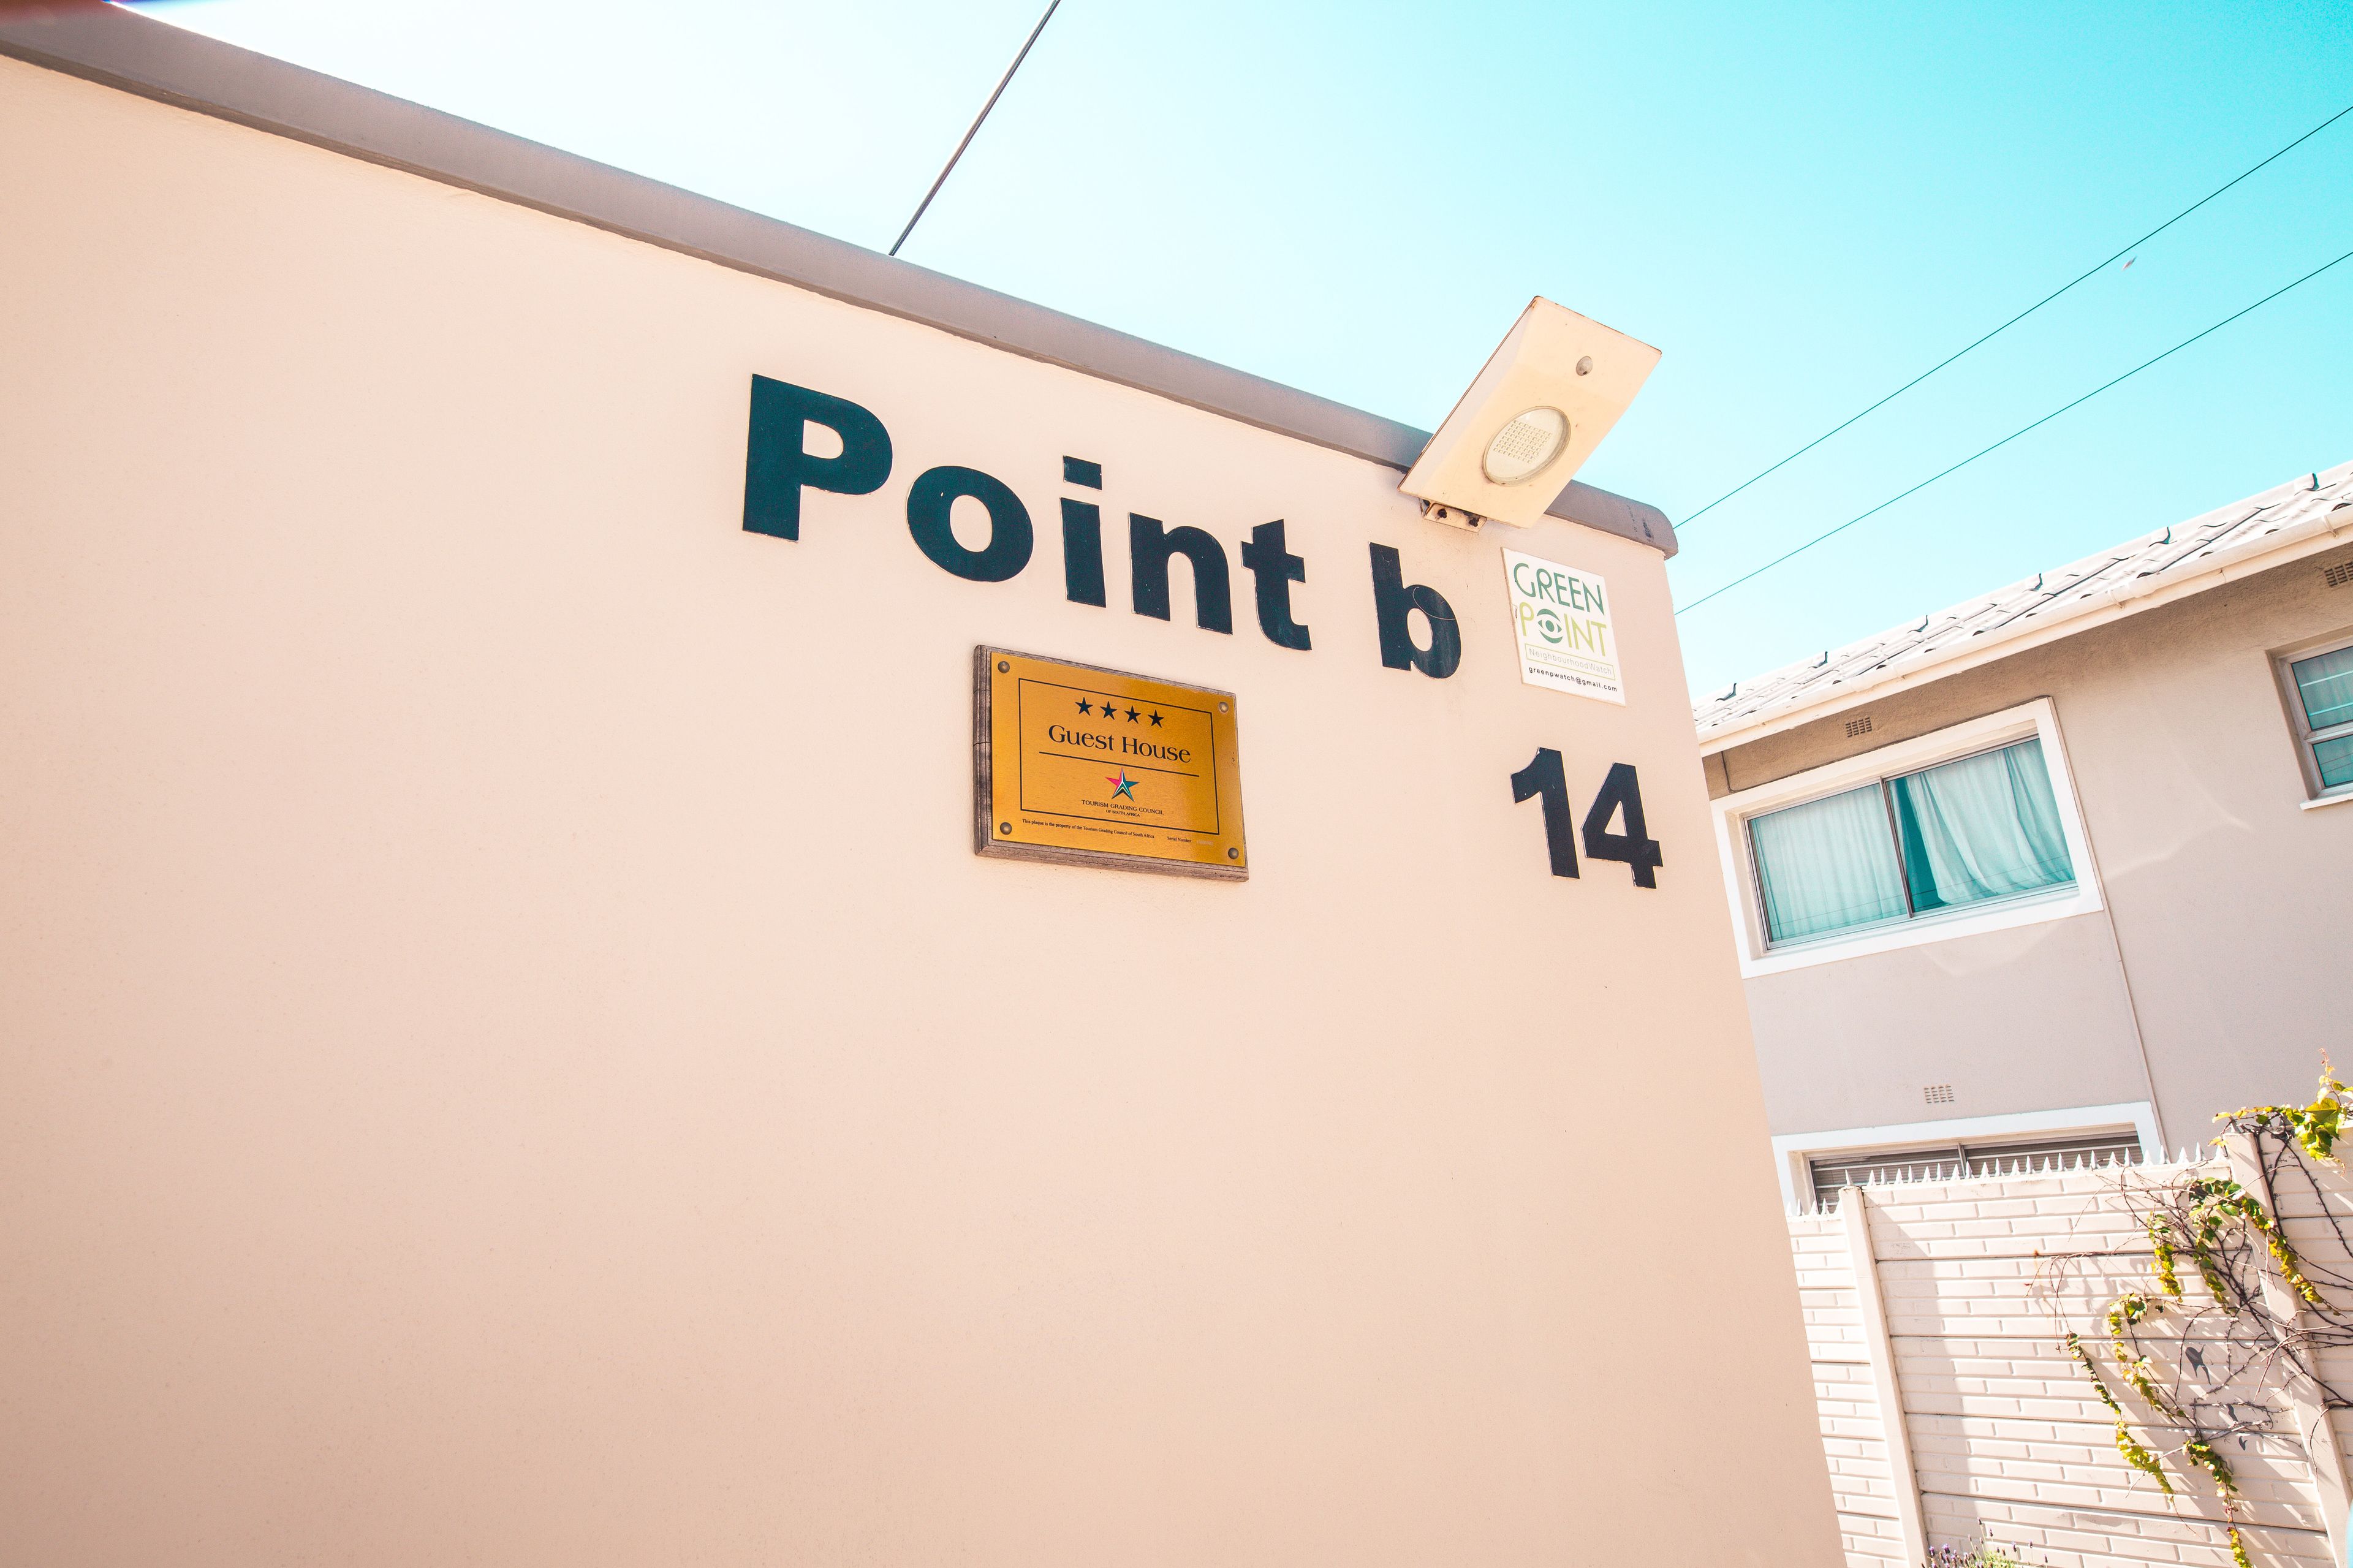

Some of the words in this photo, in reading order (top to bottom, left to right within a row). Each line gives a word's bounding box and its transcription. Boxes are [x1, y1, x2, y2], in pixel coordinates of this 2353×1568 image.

[742, 373, 1312, 651] Point
[1370, 542, 1461, 679] b
[1513, 562, 1605, 616] GREEN
[1528, 667, 1618, 692] greenpwatch@gmail.com
[1048, 724, 1114, 751] Guest
[1122, 737, 1191, 763] House
[1110, 803, 1137, 812] GRADING
[1510, 747, 1664, 889] 14
